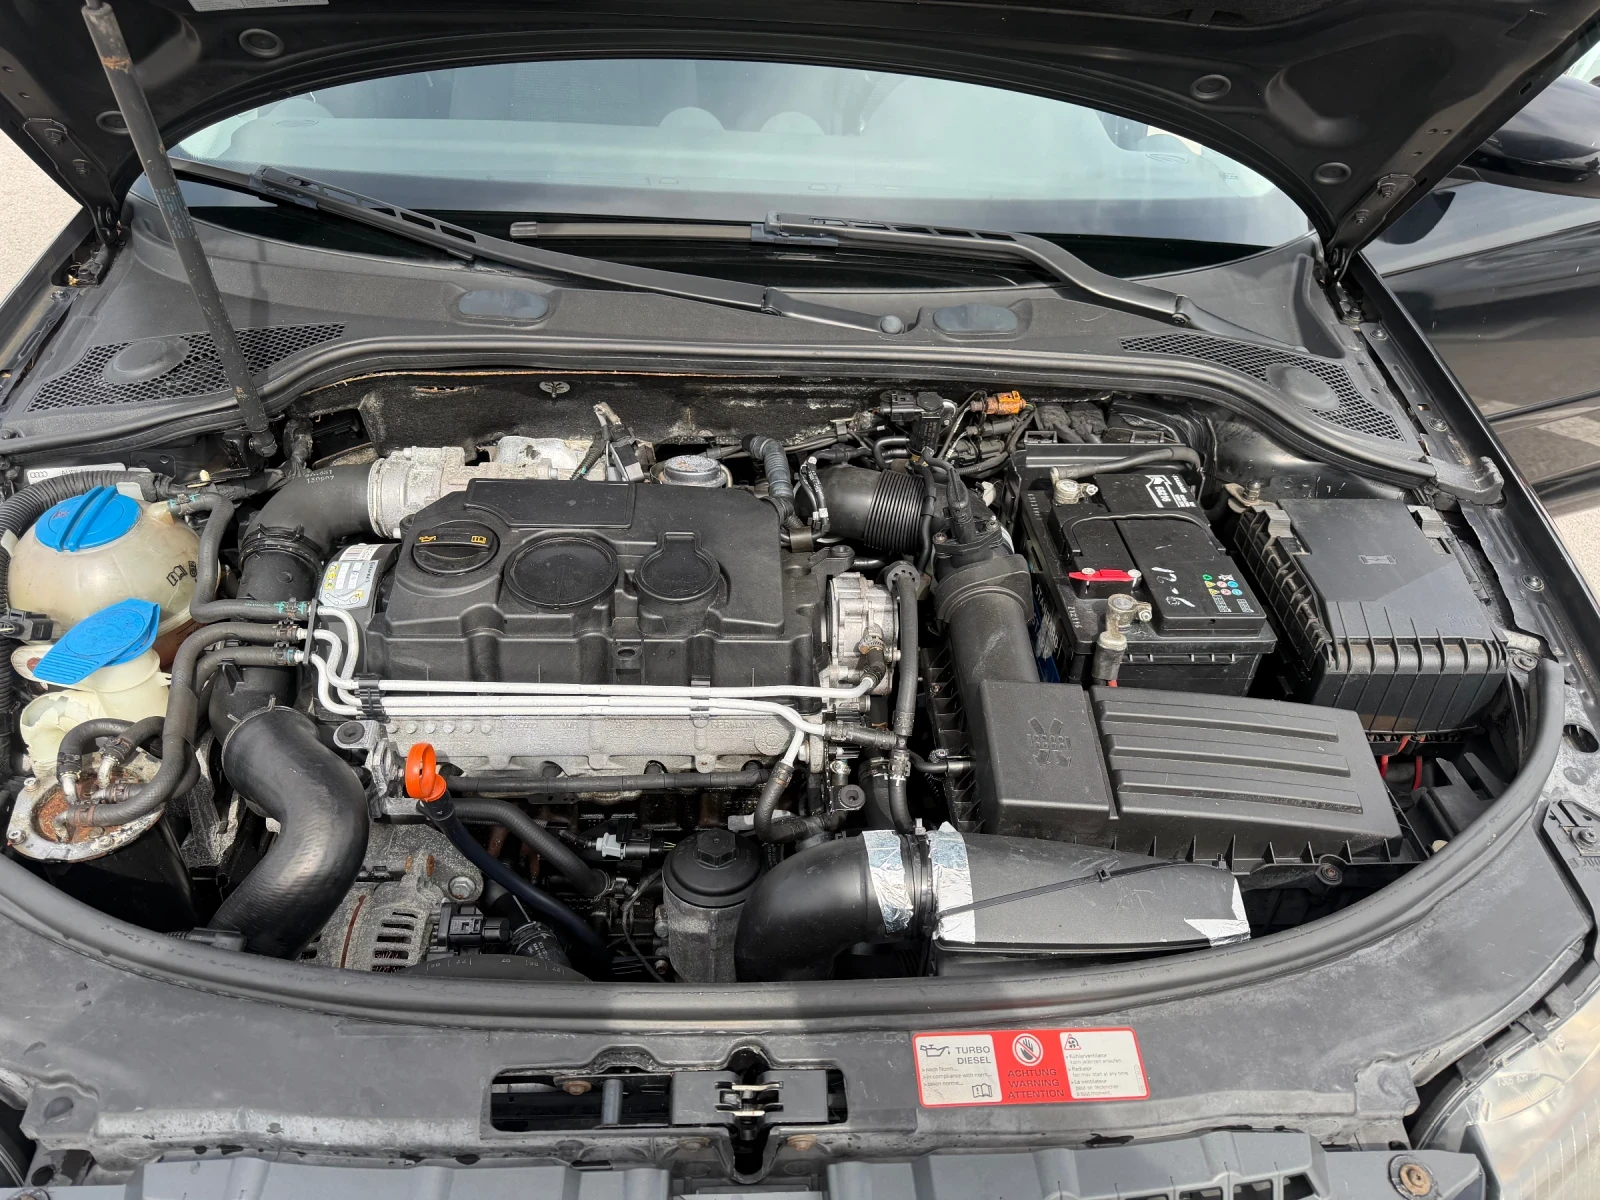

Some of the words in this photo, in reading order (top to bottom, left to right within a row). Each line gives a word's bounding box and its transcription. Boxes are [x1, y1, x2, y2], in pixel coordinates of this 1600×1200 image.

[955, 1046, 991, 1054] TURBO
[957, 1056, 992, 1065] DIESEL
[1008, 1068, 1057, 1077] ACHTUNG
[1008, 1079, 1060, 1088] WARNING
[1008, 1089, 1065, 1099] ATTENTION
